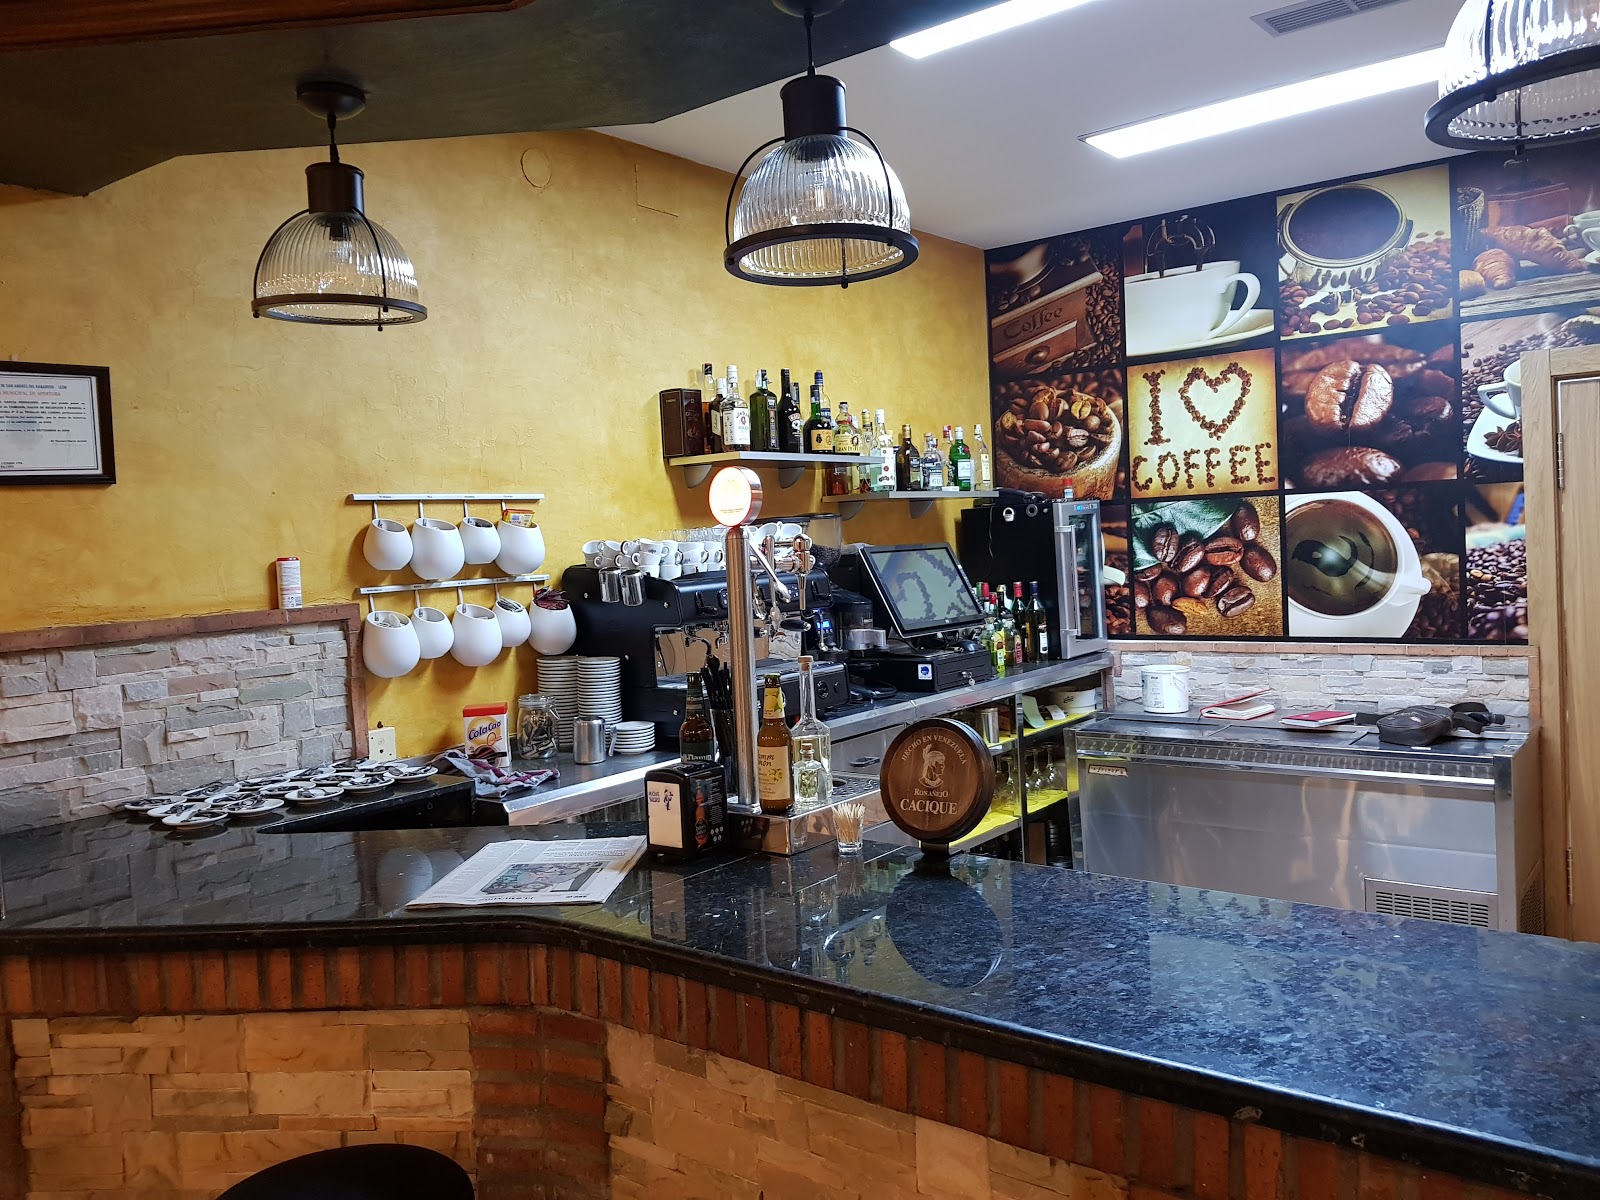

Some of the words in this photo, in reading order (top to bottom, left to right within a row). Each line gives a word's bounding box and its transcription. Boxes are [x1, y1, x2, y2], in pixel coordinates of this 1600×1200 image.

[1003, 307, 1062, 338] Coffee
[1131, 442, 1276, 491] COFFEE
[901, 740, 922, 761] HECHO
[922, 735, 932, 743] EN
[934, 735, 967, 765] VENEZUELA
[900, 798, 958, 815] CACIQUE
